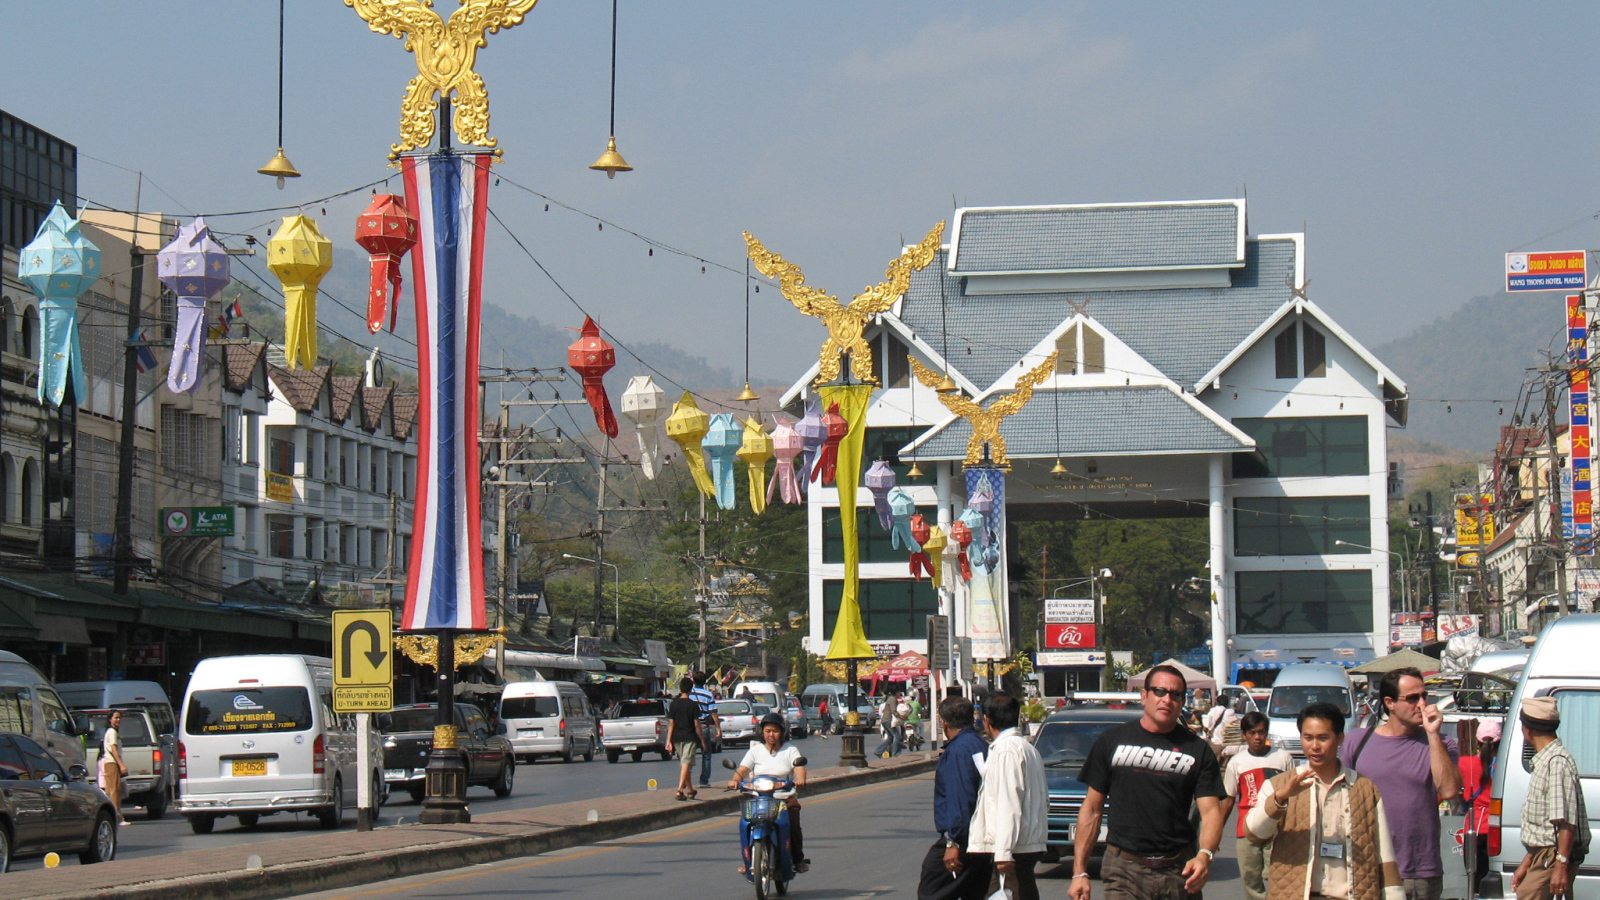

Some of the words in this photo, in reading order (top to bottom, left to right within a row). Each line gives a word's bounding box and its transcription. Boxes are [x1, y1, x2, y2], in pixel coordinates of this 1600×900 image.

[1461, 527, 1490, 536] Kodk
[1111, 744, 1196, 776] HIGHER
[234, 762, 265, 771] 30-0528
